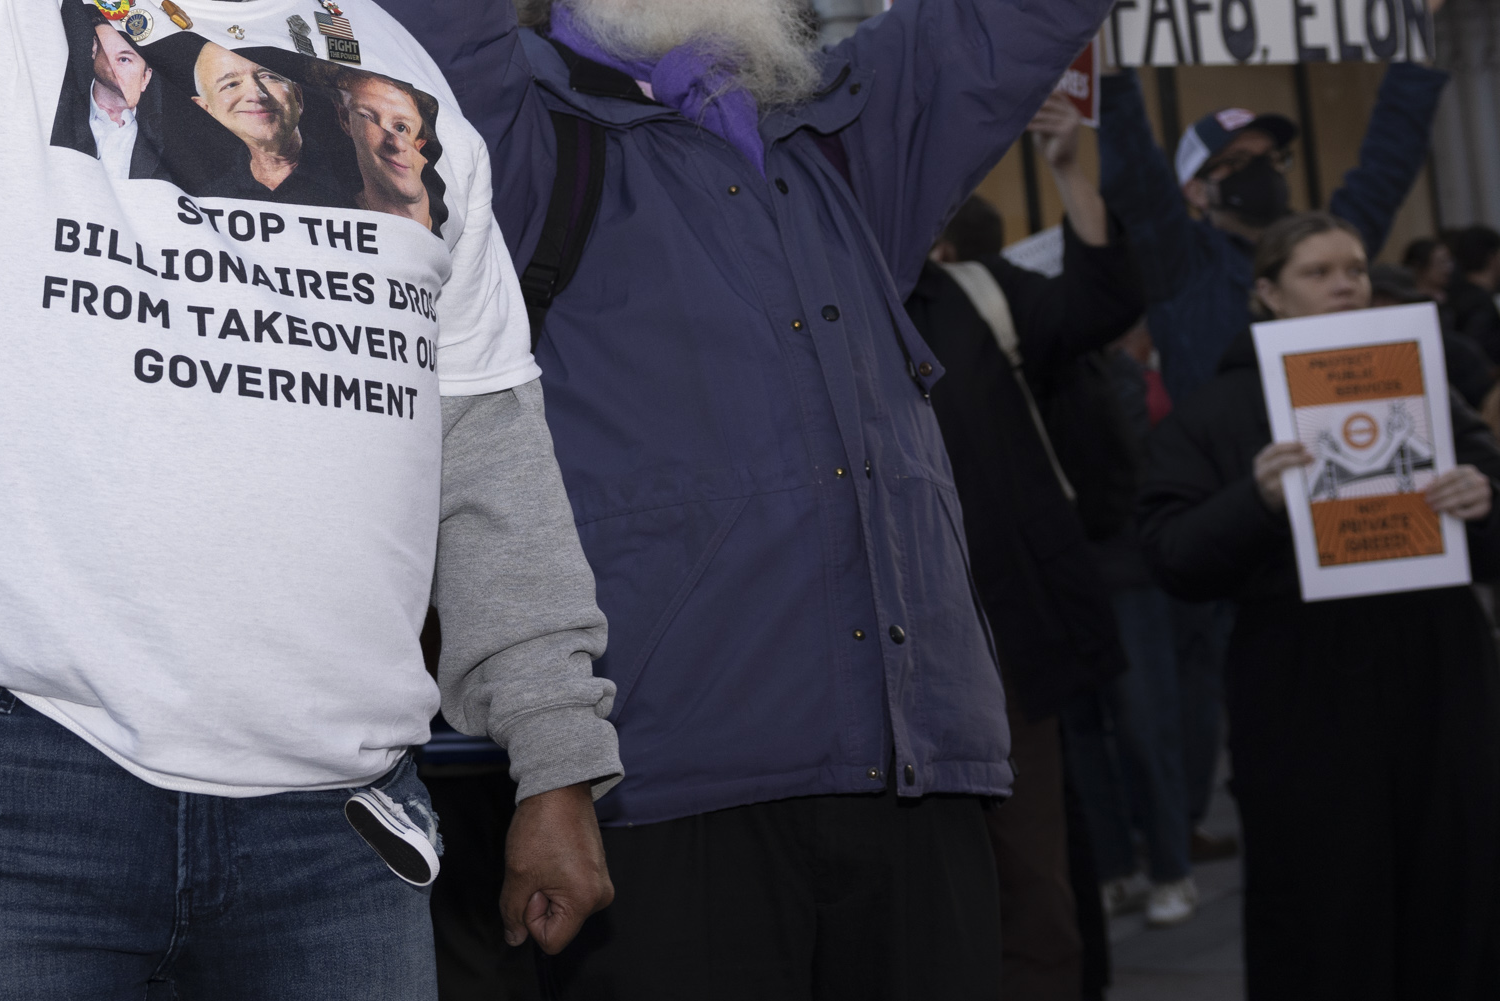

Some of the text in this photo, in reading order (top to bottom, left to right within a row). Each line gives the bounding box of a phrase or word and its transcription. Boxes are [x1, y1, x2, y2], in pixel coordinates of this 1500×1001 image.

[329, 38, 358, 53] FIGHT
[341, 52, 360, 61] POWER
[177, 195, 379, 255] STOP THE
[54, 218, 376, 305] BILLIONAIRES
[43, 275, 170, 329] FROM
[187, 305, 409, 364] TAKEOVER
[134, 348, 418, 421] GOVERNMENT
